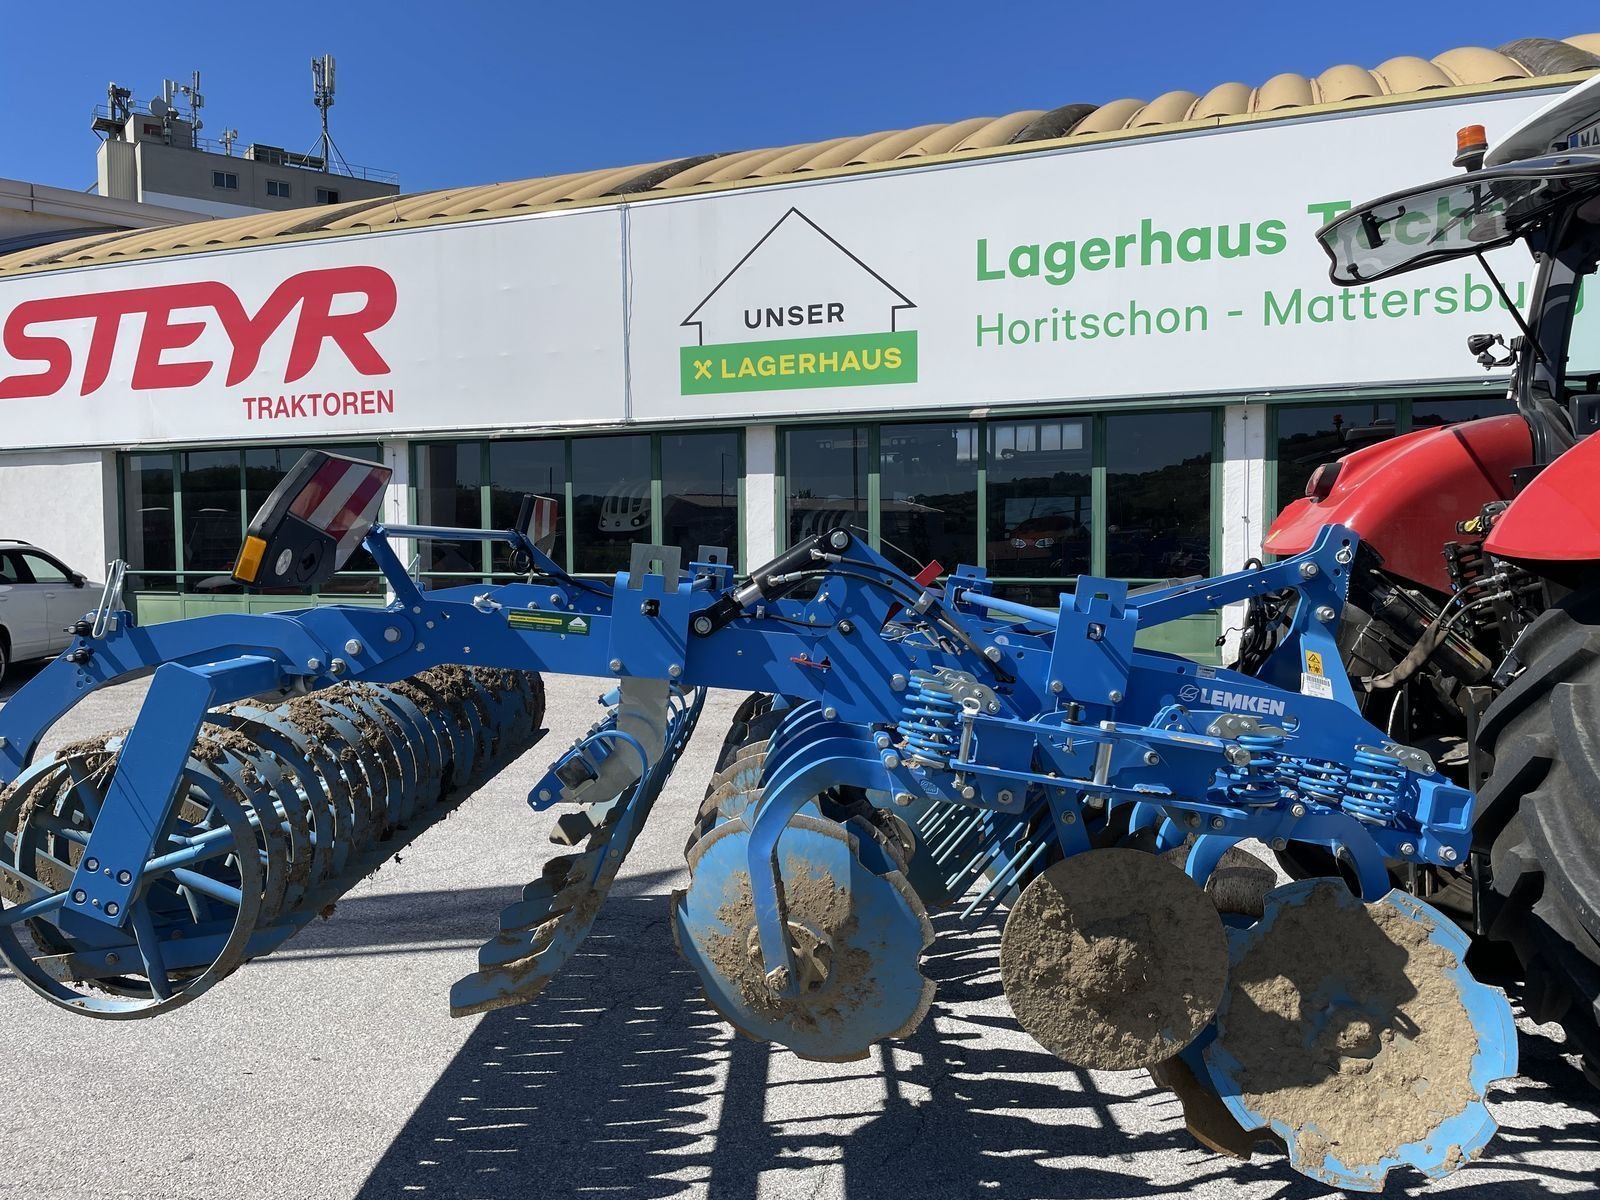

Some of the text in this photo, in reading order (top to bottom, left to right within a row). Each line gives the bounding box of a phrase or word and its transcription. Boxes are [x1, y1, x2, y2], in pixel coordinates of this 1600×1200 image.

[976, 196, 1504, 286] Lagerhaus Tech
[743, 302, 845, 329] UNSER
[976, 300, 1208, 347] Horitschon
[1263, 272, 1584, 326] Mattersbu
[0, 265, 397, 399] STEYR
[720, 347, 903, 379] LAGERHAUS
[242, 389, 395, 420] TRAKTOREN
[1199, 687, 1286, 717] LEMKEN
